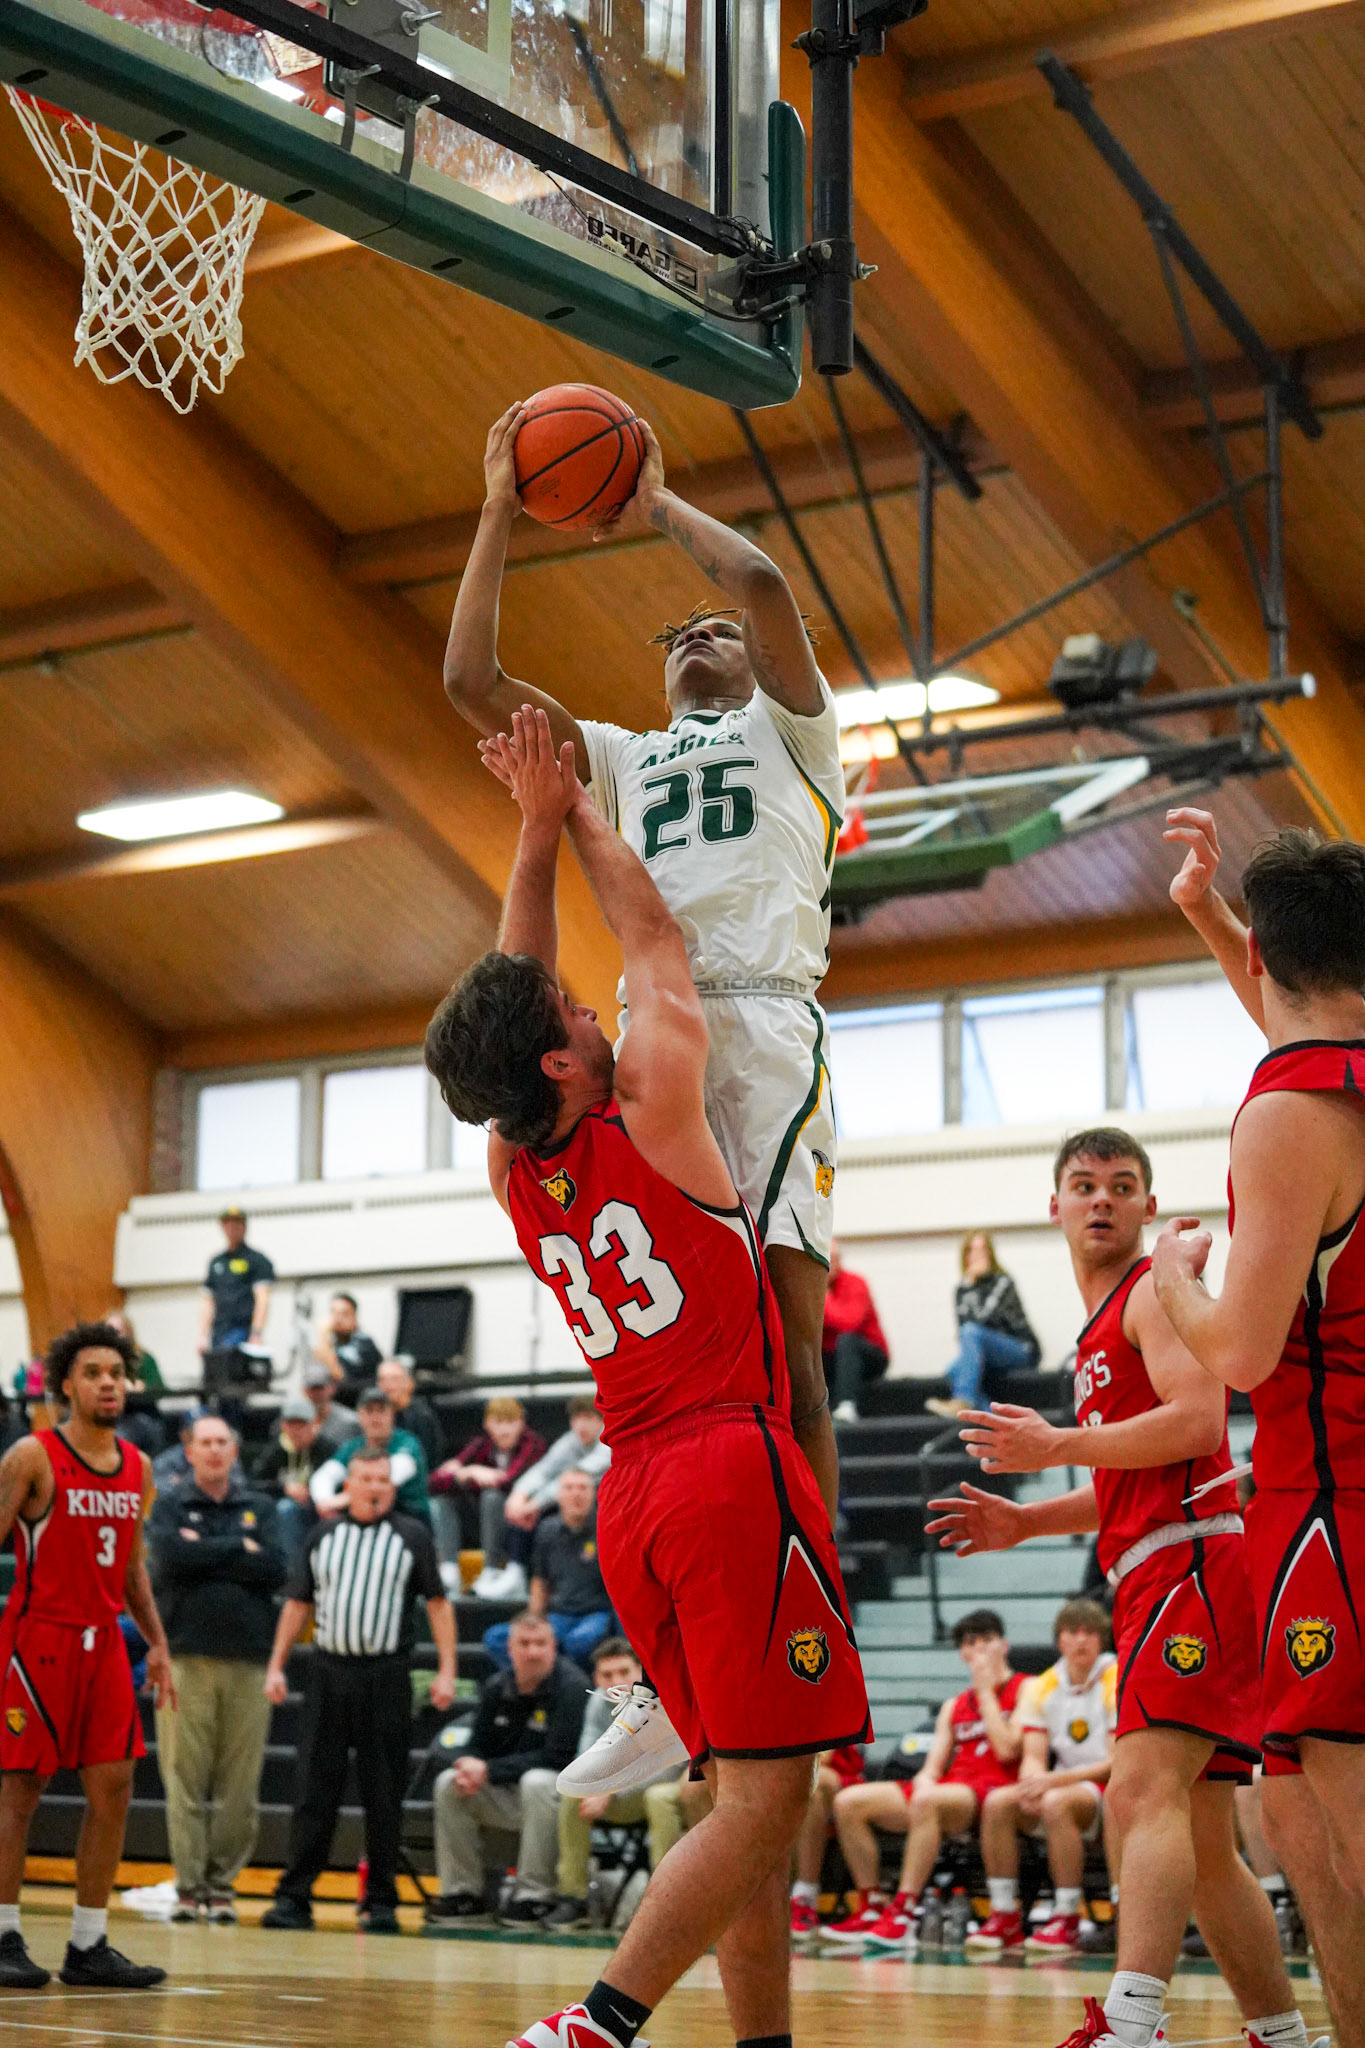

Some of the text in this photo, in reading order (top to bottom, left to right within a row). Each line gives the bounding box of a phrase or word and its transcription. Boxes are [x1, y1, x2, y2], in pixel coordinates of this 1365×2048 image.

[641, 756, 758, 864] 25
[538, 1198, 686, 1360] 33
[96, 1525, 117, 1568] 3
